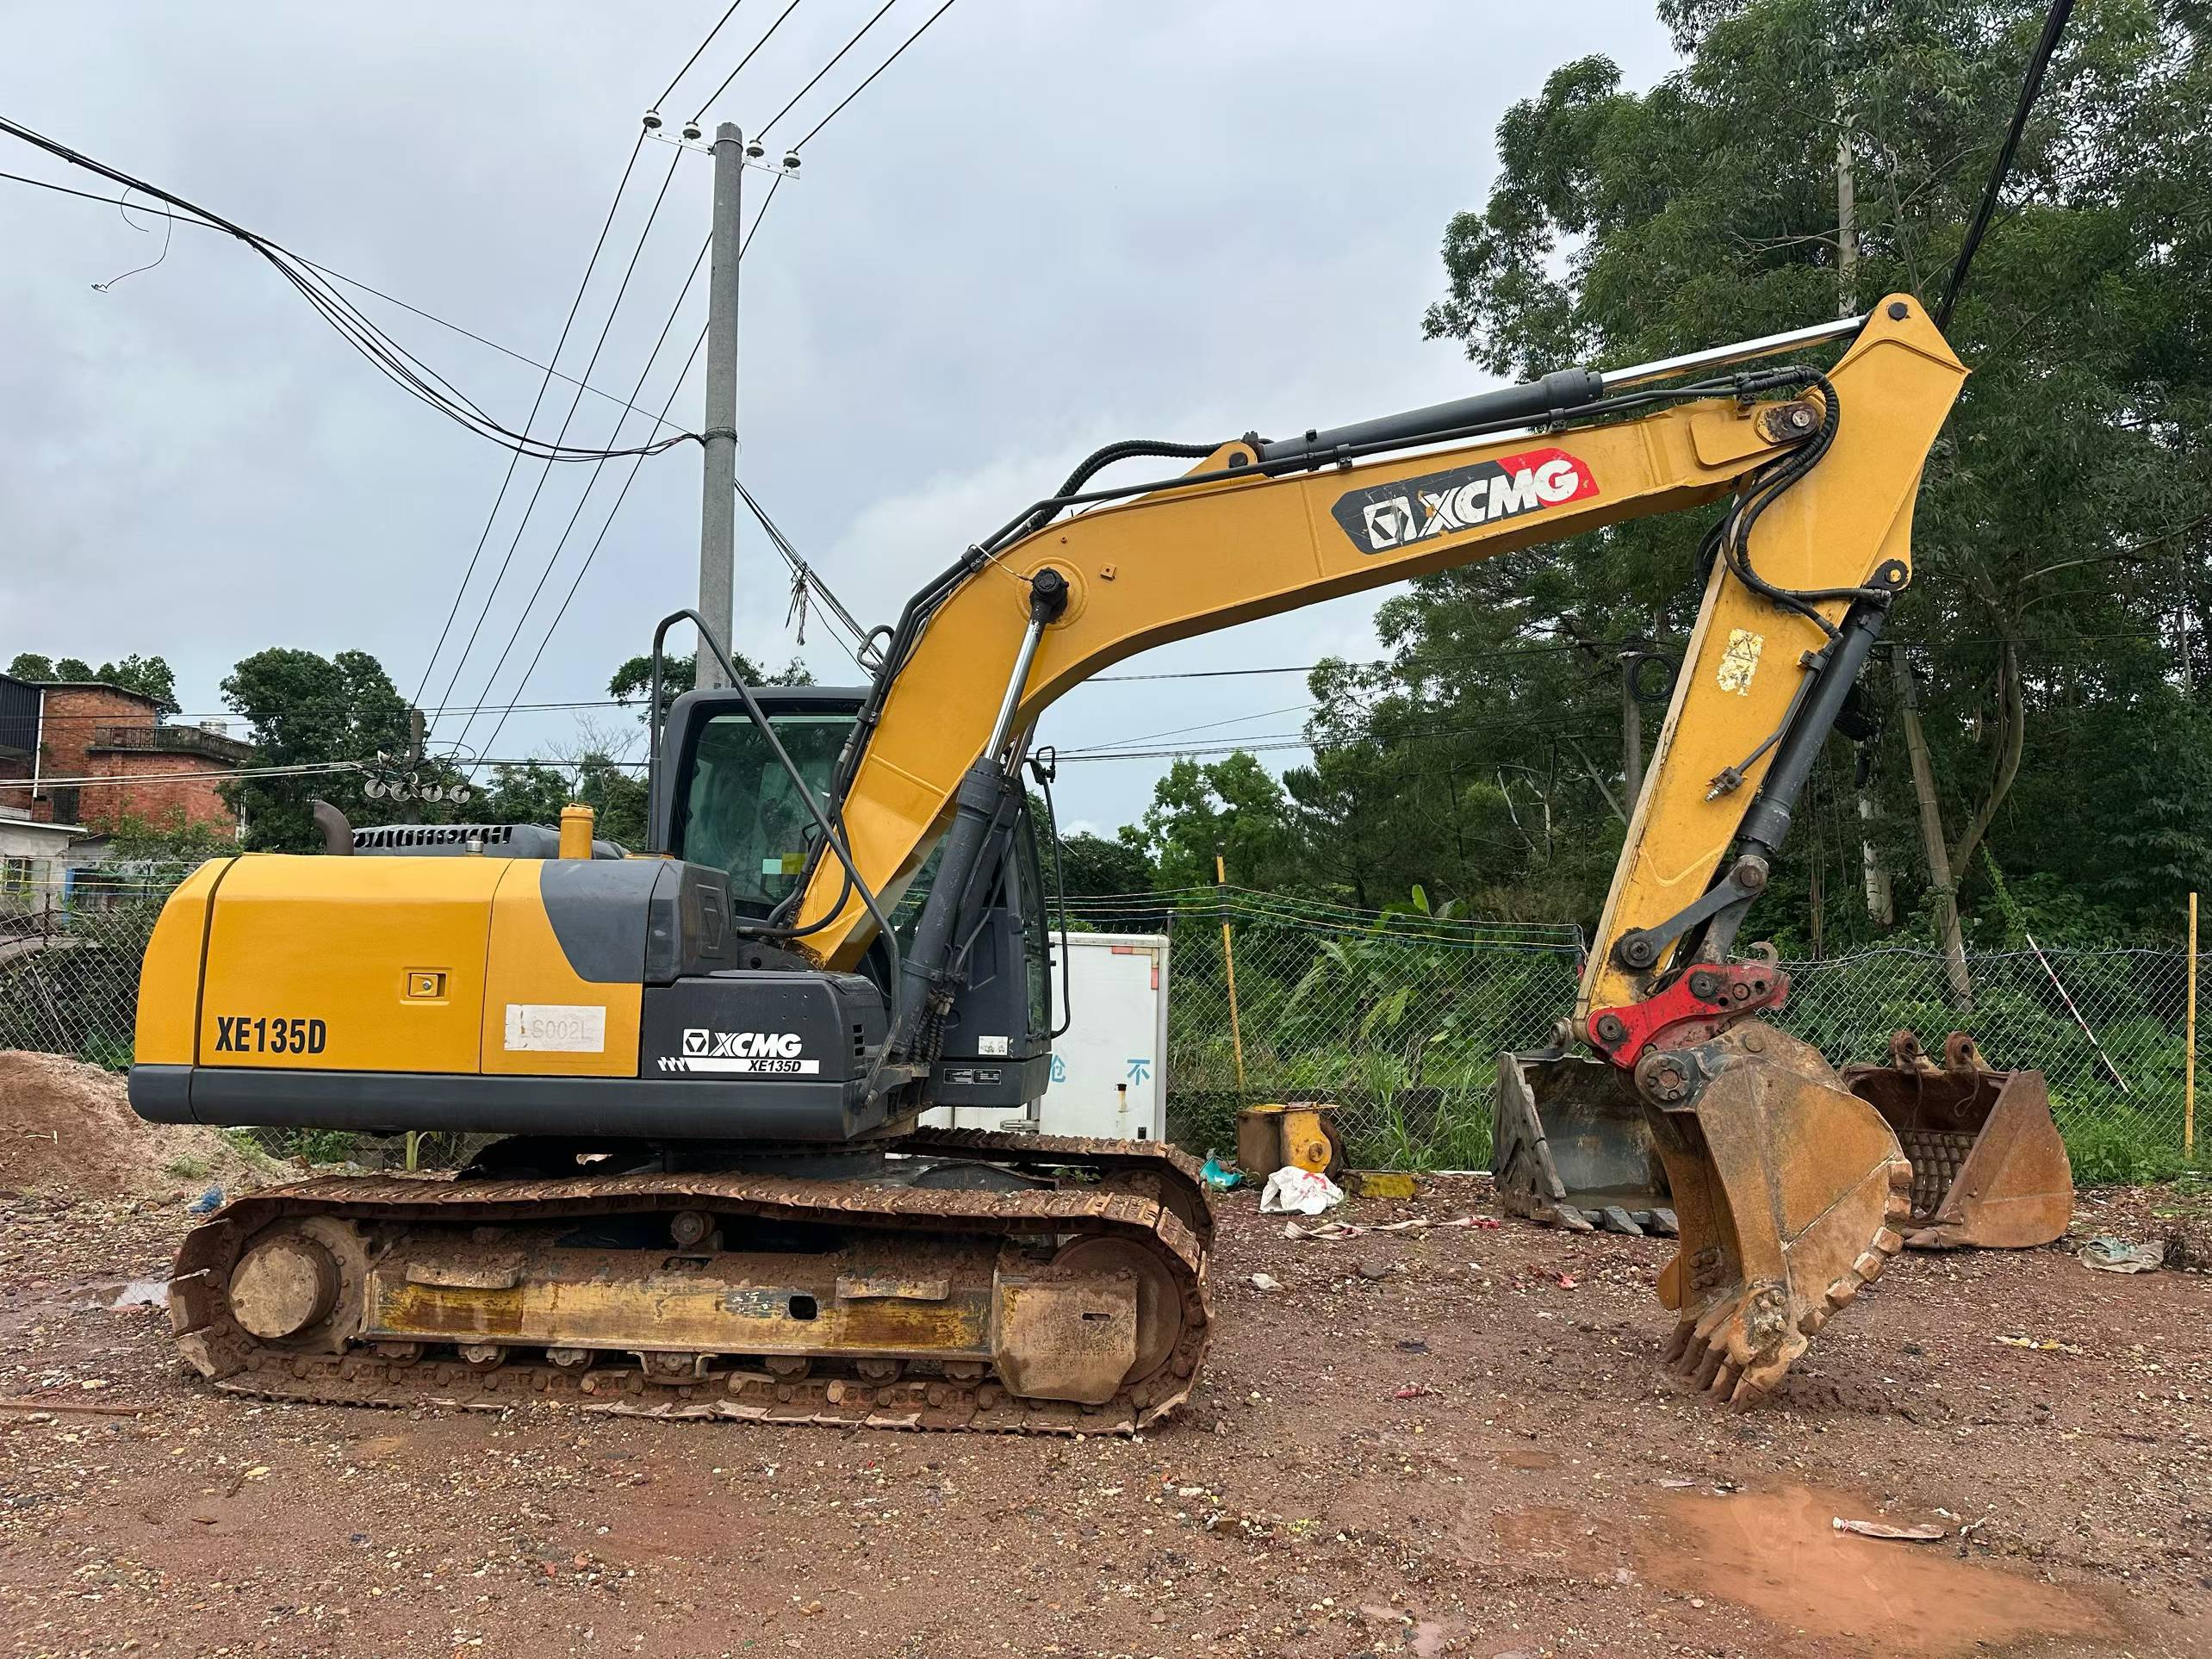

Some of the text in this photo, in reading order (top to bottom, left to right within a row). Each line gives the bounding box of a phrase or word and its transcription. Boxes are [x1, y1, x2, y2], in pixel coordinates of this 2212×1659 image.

[1417, 459, 1579, 537] XCMG
[215, 1016, 326, 1053] XE135D
[708, 1032, 803, 1058] XCMG
[749, 1059, 802, 1072] XE135D
